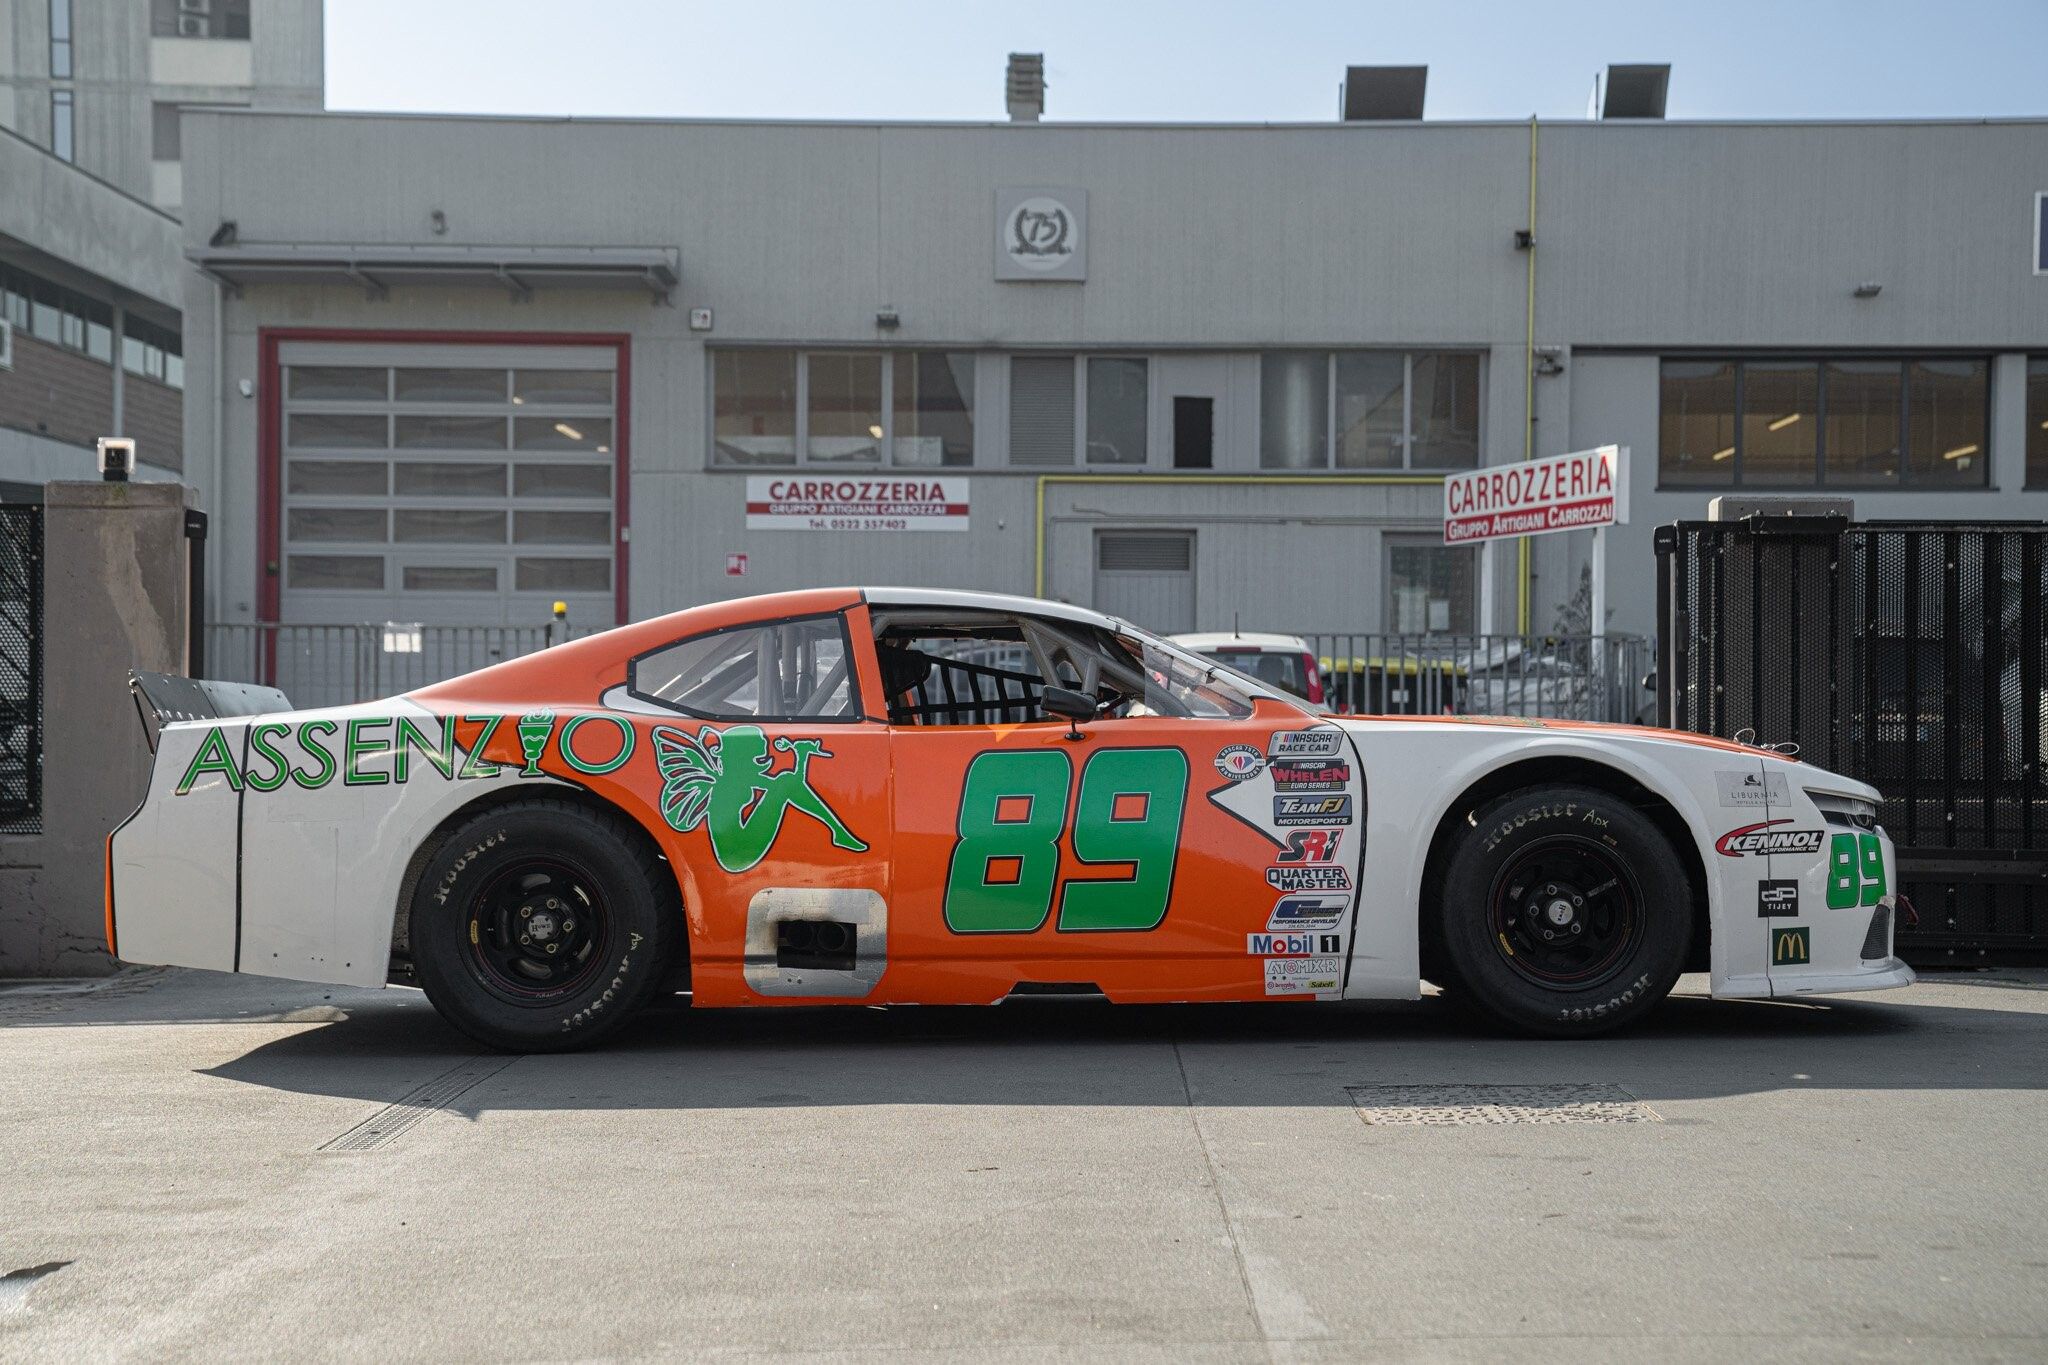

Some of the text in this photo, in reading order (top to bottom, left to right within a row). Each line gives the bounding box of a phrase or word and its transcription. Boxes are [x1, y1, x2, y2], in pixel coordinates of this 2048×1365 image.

[769, 481, 946, 502] CARROZZERIA
[1449, 455, 1611, 514] CARROZZERIA
[769, 503, 947, 515] GRUPPO ARTIGIANI CARROZZAI
[1449, 503, 1613, 539] GRUPPO ARTIGIANI CARROZZAI
[1293, 733, 1332, 743] NASCAR
[1278, 744, 1330, 752] RACE CAR
[1270, 765, 1350, 782] WHELEN
[1731, 791, 1779, 799] LIBURNIA
[1277, 817, 1349, 825] MOTORSPORTS
[942, 745, 1191, 935] 89
[1278, 830, 1341, 862] SRI
[1724, 832, 1820, 851] KENNOL
[1759, 846, 1808, 854] PERFORMANCE
[1268, 868, 1343, 884] QUARTER
[1826, 832, 1887, 910] 89
[1281, 879, 1347, 890] MASTER
[1253, 934, 1314, 954] Mobil
